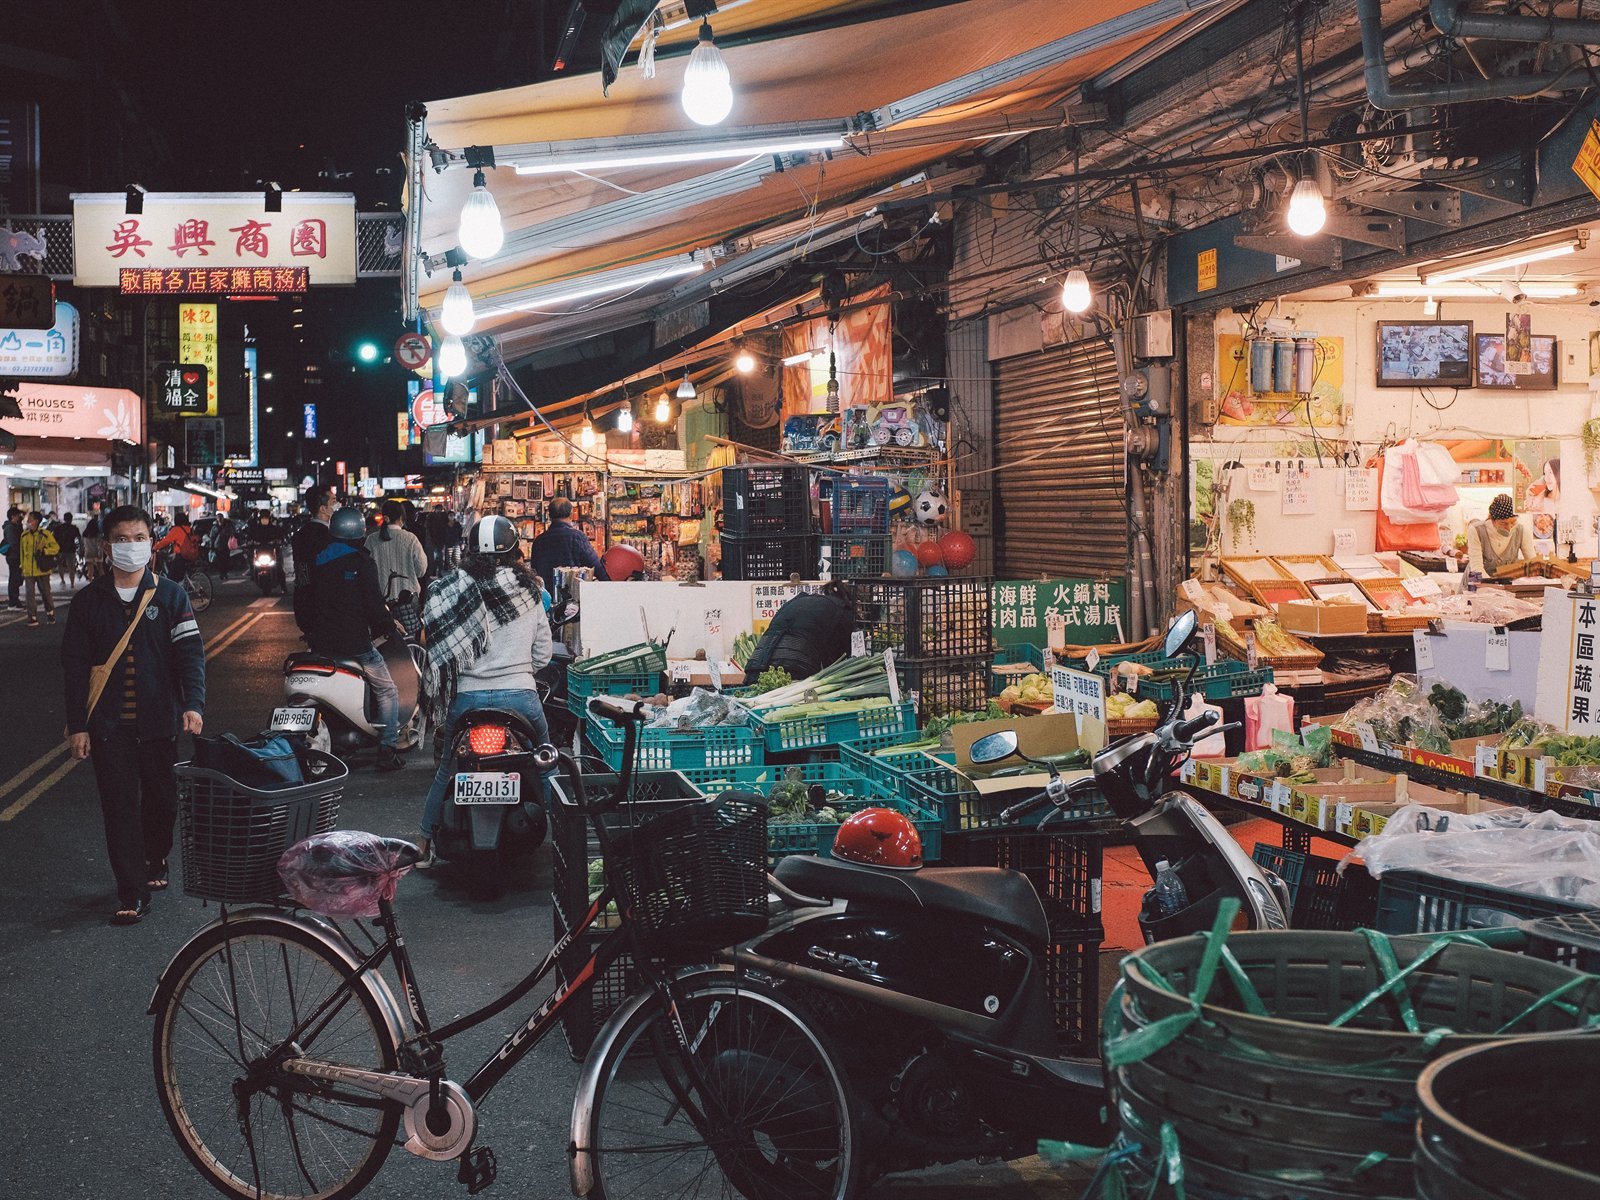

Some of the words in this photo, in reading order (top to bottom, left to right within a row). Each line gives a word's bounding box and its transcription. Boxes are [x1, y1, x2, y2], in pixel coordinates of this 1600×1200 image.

[106, 219, 326, 259] 吳興商圈
[182, 308, 214, 324] 陳記
[164, 368, 181, 387] 清
[165, 388, 199, 407] 福全
[755, 585, 785, 596] 本區商品
[1053, 583, 1110, 605] 火鍋料
[1044, 605, 1120, 627] 各式湯底
[1572, 602, 1596, 723] 本區蔬果
[457, 781, 515, 796] MBZ-8131
